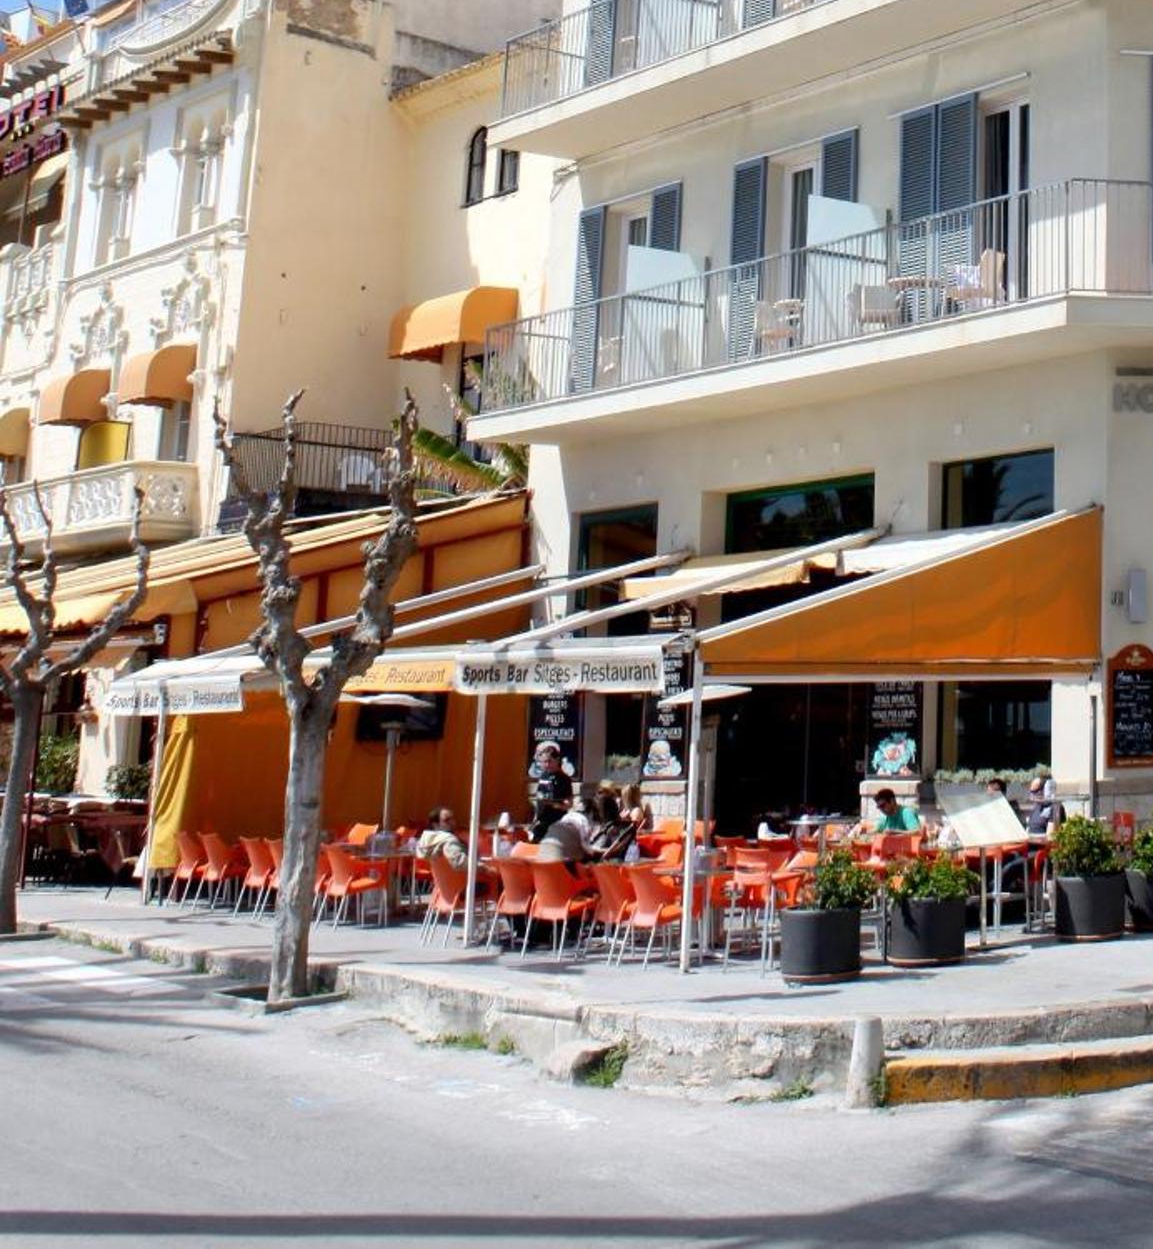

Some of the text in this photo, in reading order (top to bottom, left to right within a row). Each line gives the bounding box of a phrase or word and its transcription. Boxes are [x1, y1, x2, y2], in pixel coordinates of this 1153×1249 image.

[385, 667, 446, 684] Restaurant
[462, 664, 500, 688] Sports
[506, 664, 528, 683] Bar
[534, 662, 570, 688] Sitges
[580, 661, 658, 683] Restaurant
[142, 693, 160, 709] Bar
